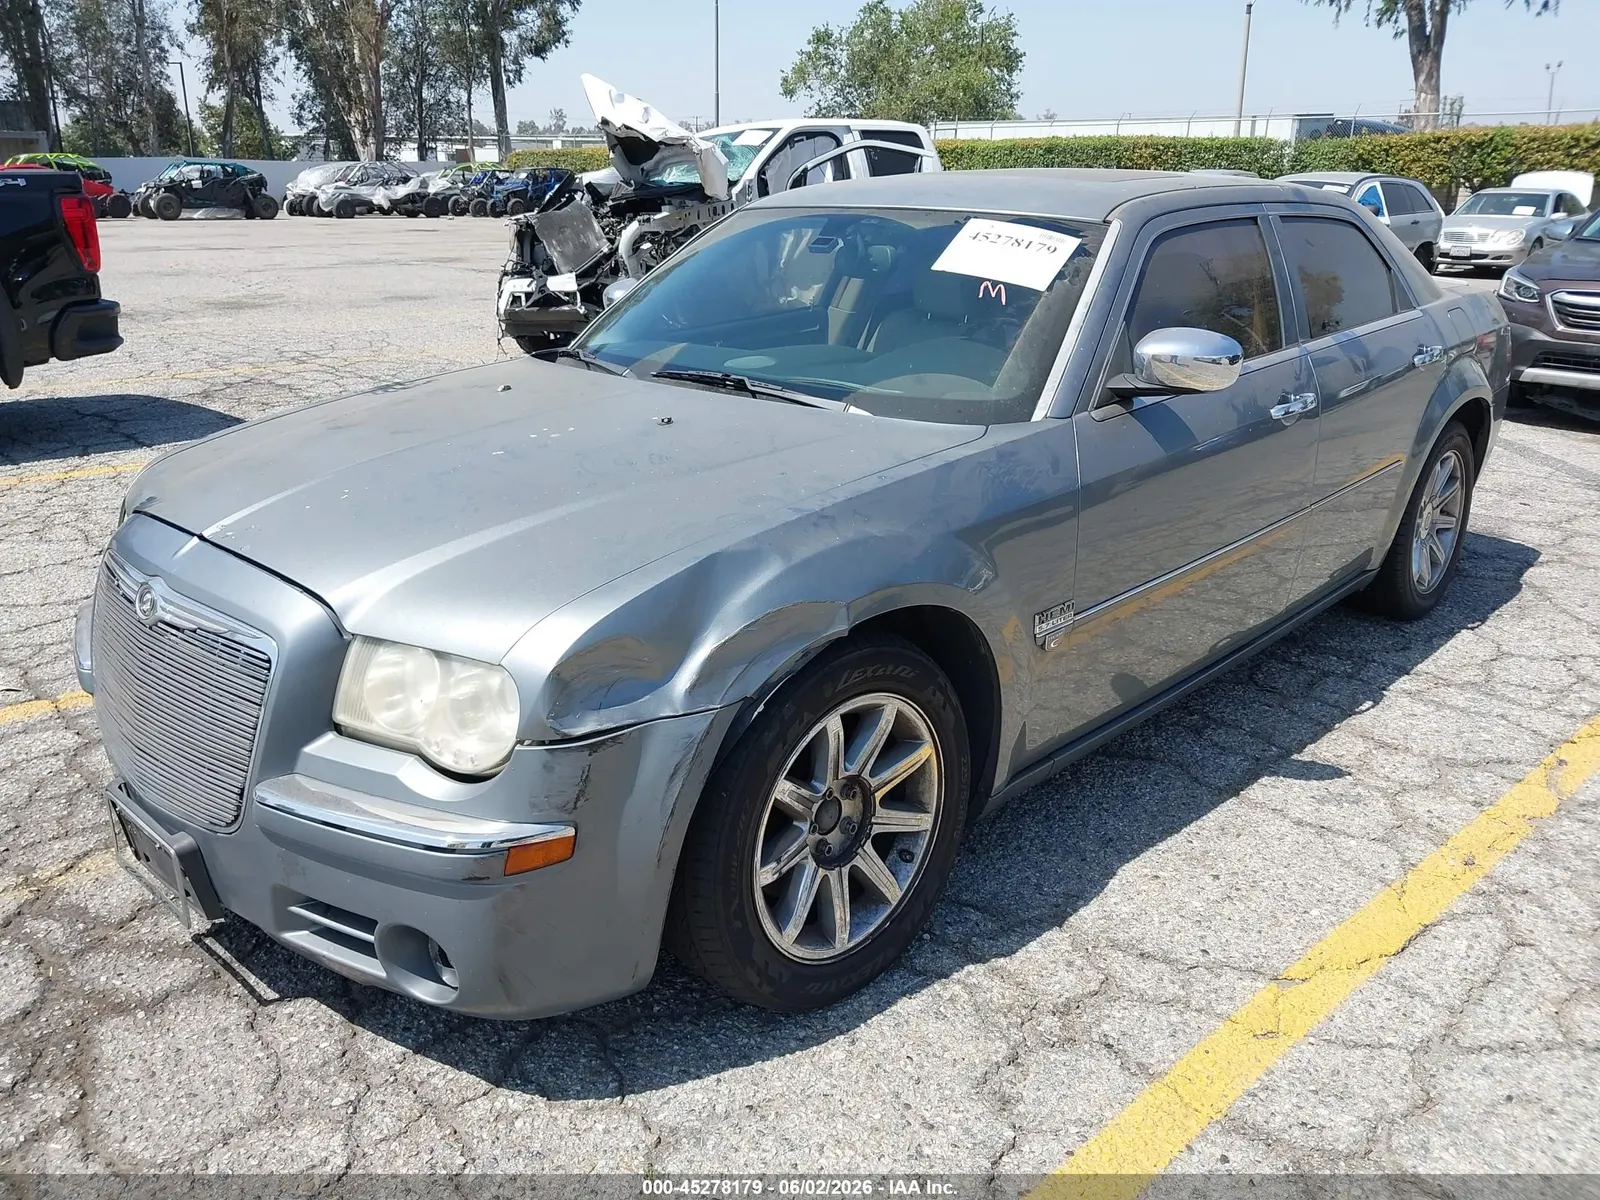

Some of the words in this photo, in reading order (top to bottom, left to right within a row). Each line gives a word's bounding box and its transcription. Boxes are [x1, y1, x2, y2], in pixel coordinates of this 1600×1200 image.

[969, 231, 1058, 254] 45278179
[978, 281, 1006, 305] M
[1038, 602, 1074, 624] HEMI
[1052, 613, 1073, 625] LITER
